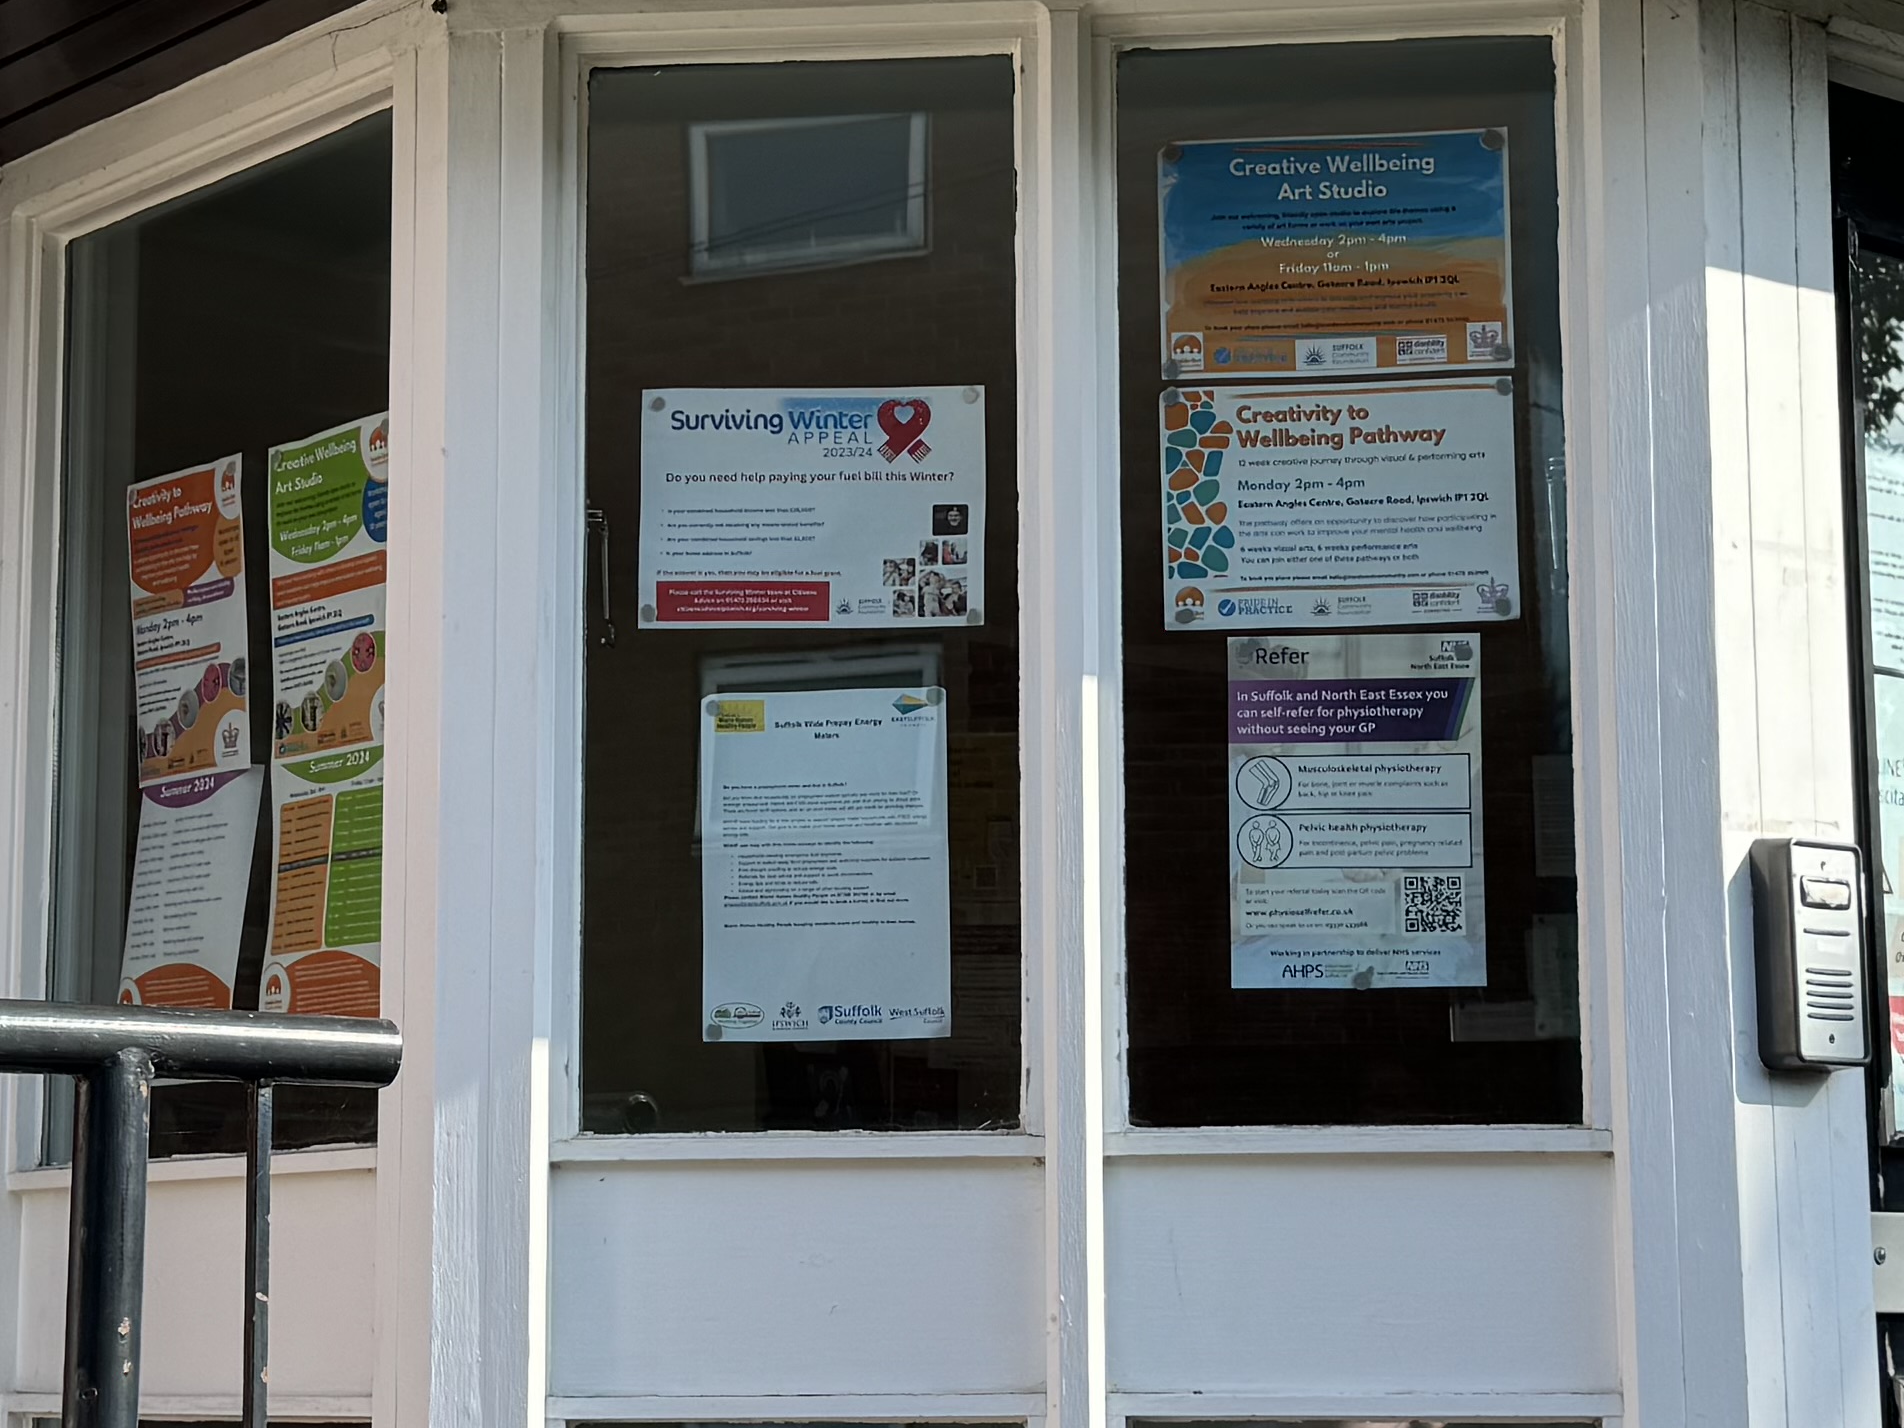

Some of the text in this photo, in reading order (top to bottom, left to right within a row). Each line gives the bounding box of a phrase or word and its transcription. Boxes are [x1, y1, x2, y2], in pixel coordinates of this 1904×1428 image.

[1229, 153, 1434, 176] Creative Wellbeing
[1278, 180, 1387, 200] Art Studio
[1261, 233, 1406, 249] Wednesday 2pm 4pm
[1280, 261, 1389, 275] Friday 11am 1pm
[671, 409, 872, 434] Surviving Winter
[1236, 404, 1369, 425] Creativity to
[788, 431, 872, 444] APPEAL
[1237, 425, 1445, 450] Wellbeing Pathway
[315, 439, 356, 461] Wellbeing
[823, 447, 872, 458] 2023/24
[1273, 457, 1308, 465] creative
[1310, 457, 1342, 467] journey
[1344, 456, 1379, 465] through
[1382, 453, 1406, 463] visual
[1418, 452, 1466, 463] performing
[276, 473, 323, 494] Art Studio
[667, 471, 954, 484] Do you need help paying your fuel bill this Winter?
[1238, 477, 1365, 492] Monday 2pm 4pm
[173, 487, 182, 498] to
[1276, 499, 1307, 509] Angles
[1309, 498, 1343, 507] Centre,
[1387, 495, 1414, 504] Road,
[1417, 494, 1452, 504] Ipswich
[132, 510, 172, 529] Wellbeing
[1239, 605, 1292, 615] PRACTICE
[1256, 648, 1309, 664] Refer
[1237, 690, 1448, 701] In Suffolk and North East Essex you
[1237, 706, 1423, 720] can self-refer for physiotherapy
[855, 718, 882, 727] Energy
[1237, 723, 1376, 736] without seeing your GP
[309, 751, 370, 773] Summer 2024
[1298, 765, 1441, 774] Musculoskeletal physiotherapy
[161, 783, 192, 798] Summer
[1328, 823, 1357, 831] health
[1360, 823, 1427, 833] physiotherapy
[1270, 949, 1301, 957] Working
[1312, 949, 1354, 957] partnership
[1282, 964, 1323, 978] AHPS
[835, 1005, 881, 1017] Suffolk
[890, 1008, 912, 1017] West
